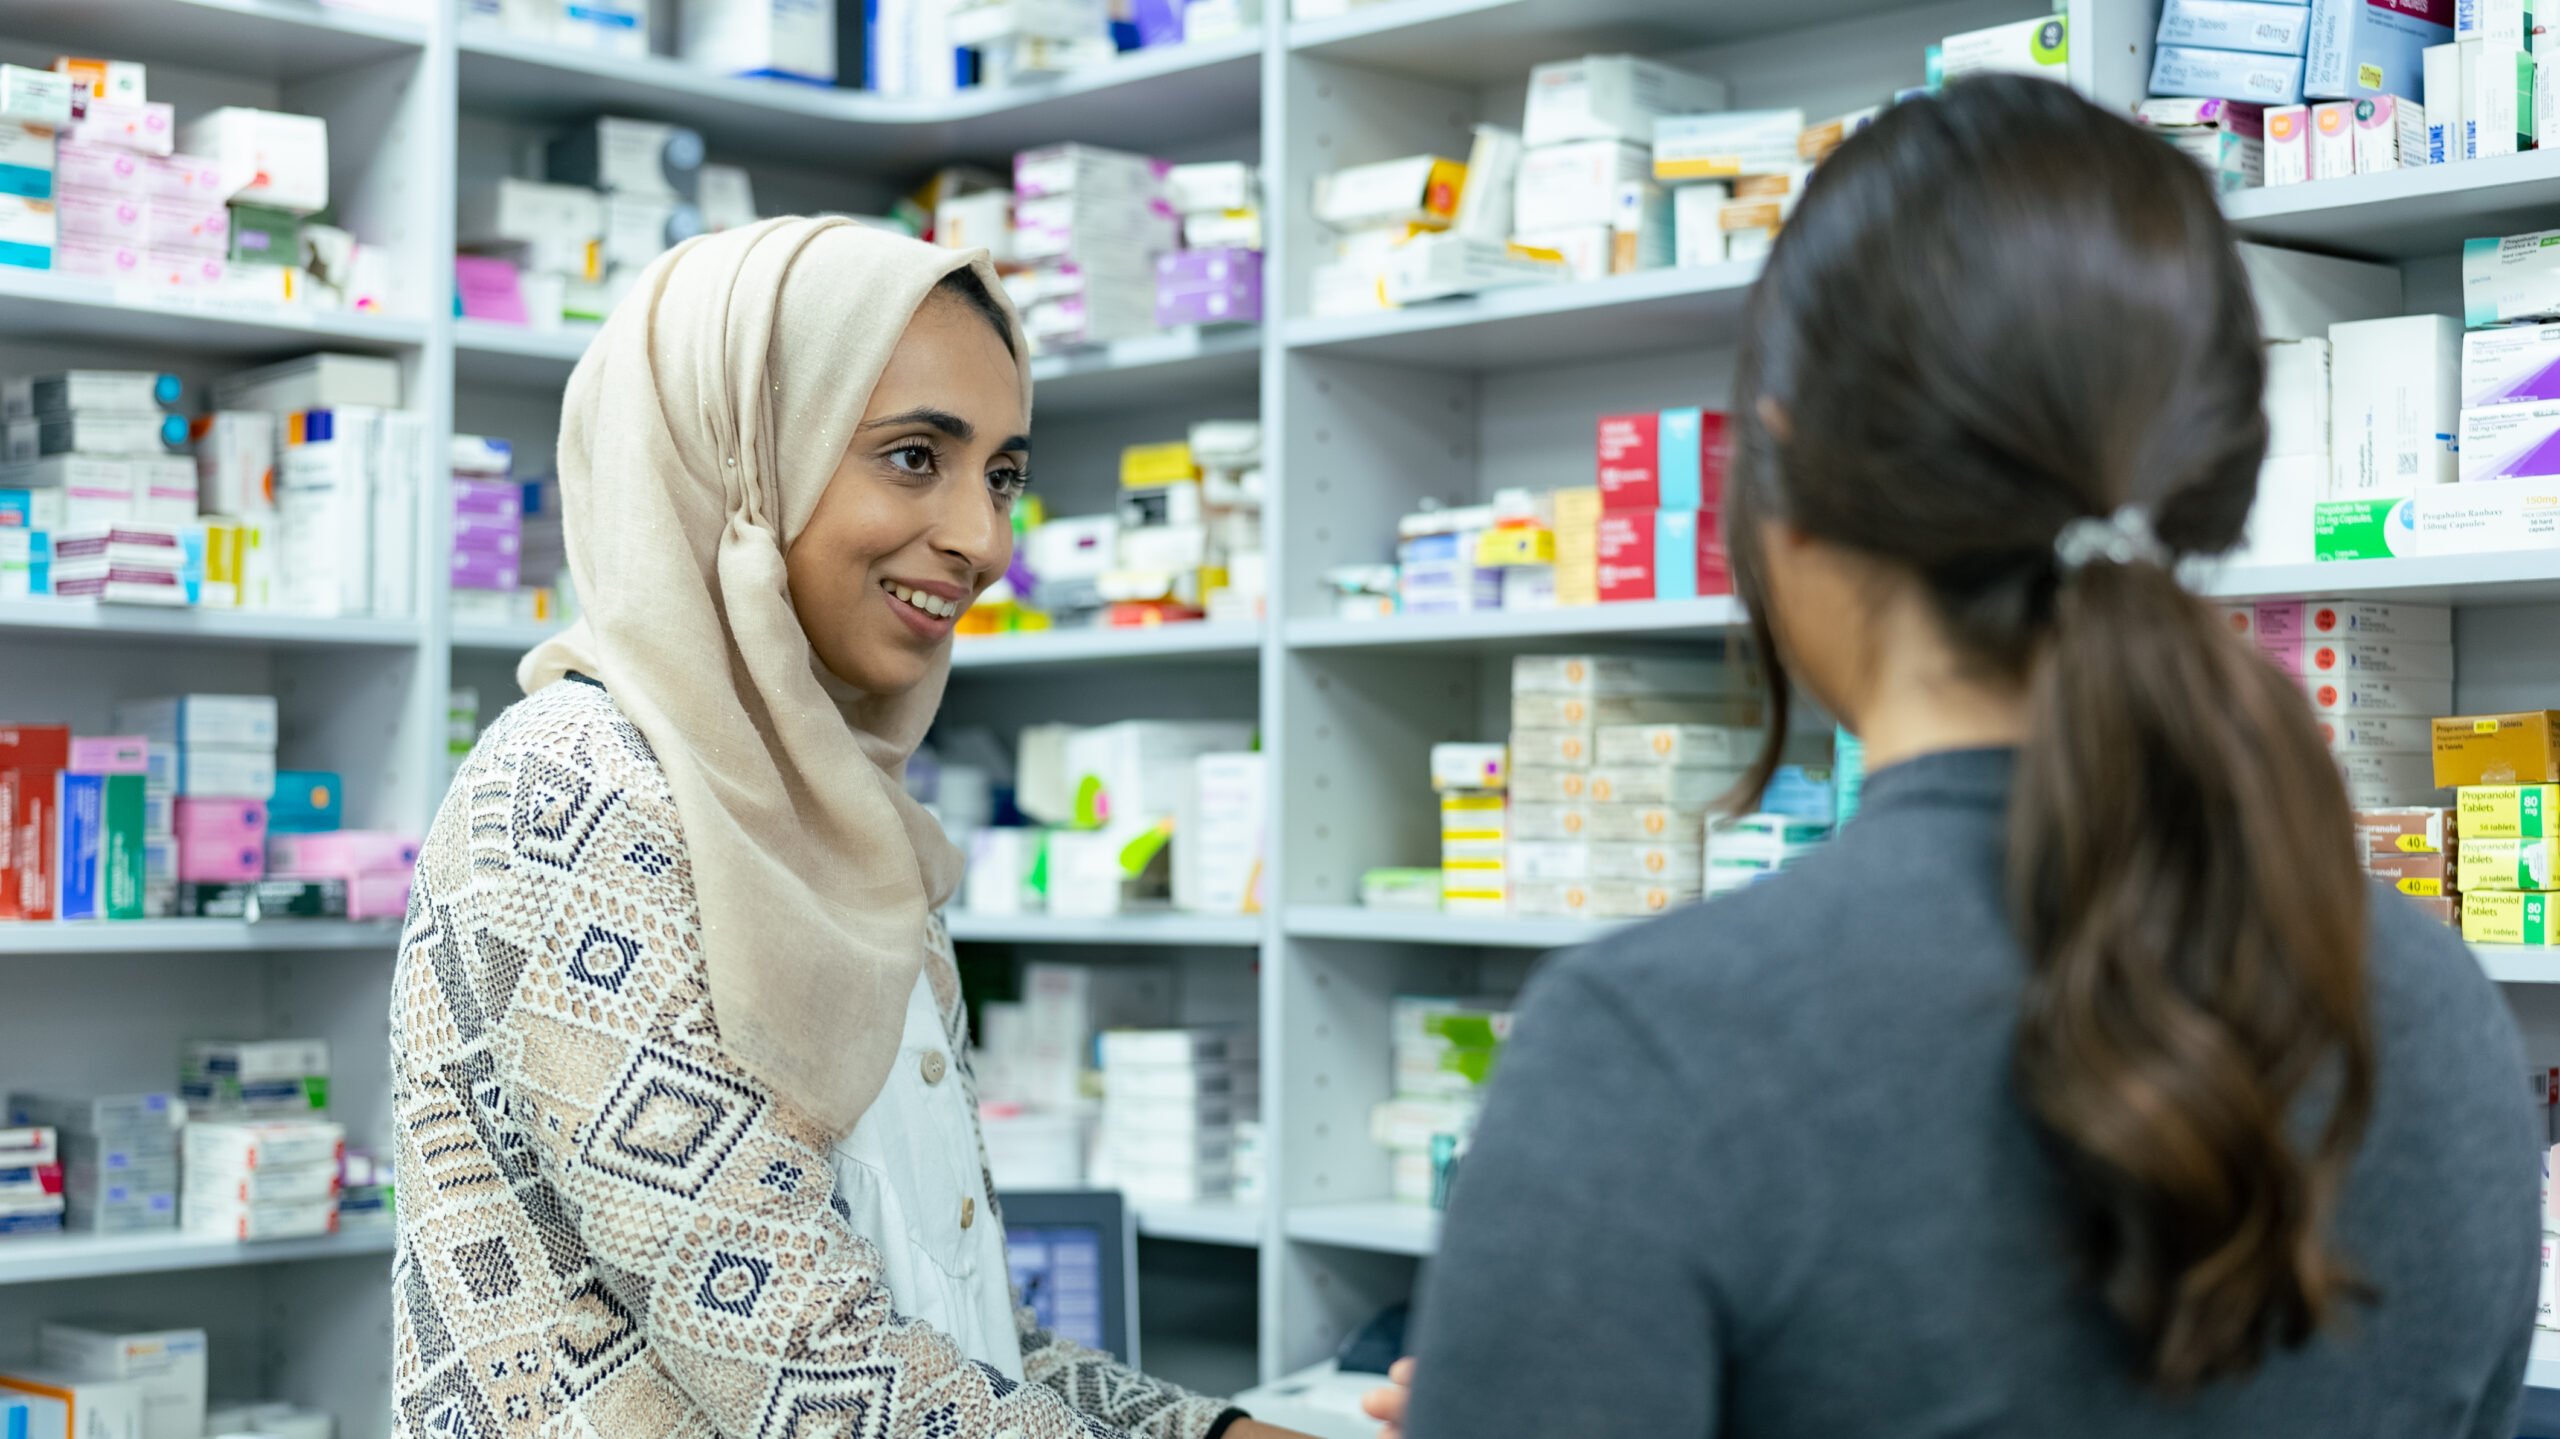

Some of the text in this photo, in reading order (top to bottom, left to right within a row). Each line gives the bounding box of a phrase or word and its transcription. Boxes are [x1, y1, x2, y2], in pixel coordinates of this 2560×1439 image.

[2256, 23, 2291, 43] 40mg
[2249, 73, 2284, 94] 40mg
[2526, 495, 2559, 505] 150mg
[2422, 509, 2466, 521] Pregabalin
[2326, 516, 2339, 527] mg
[2449, 520, 2486, 530] Capsules
[2528, 525, 2555, 534] capsules
[2500, 719, 2523, 729] Tablets
[2462, 790, 2516, 801] Propranolol
[2523, 795, 2538, 808] 80
[2462, 803, 2495, 813] Tablets
[2524, 807, 2538, 817] mg
[2490, 823, 2516, 832] tablets
[2406, 836, 2421, 849] 40
[2462, 842, 2516, 852] Propranolol
[2463, 855, 2493, 864] Tablets
[2488, 874, 2514, 883] tablets
[2406, 880, 2438, 896] 40 mg
[2466, 894, 2520, 905] Propranolol
[2466, 906, 2498, 917] Tablets
[2527, 902, 2541, 914] 80
[2527, 914, 2541, 924] mg
[2492, 927, 2519, 937] tablets
